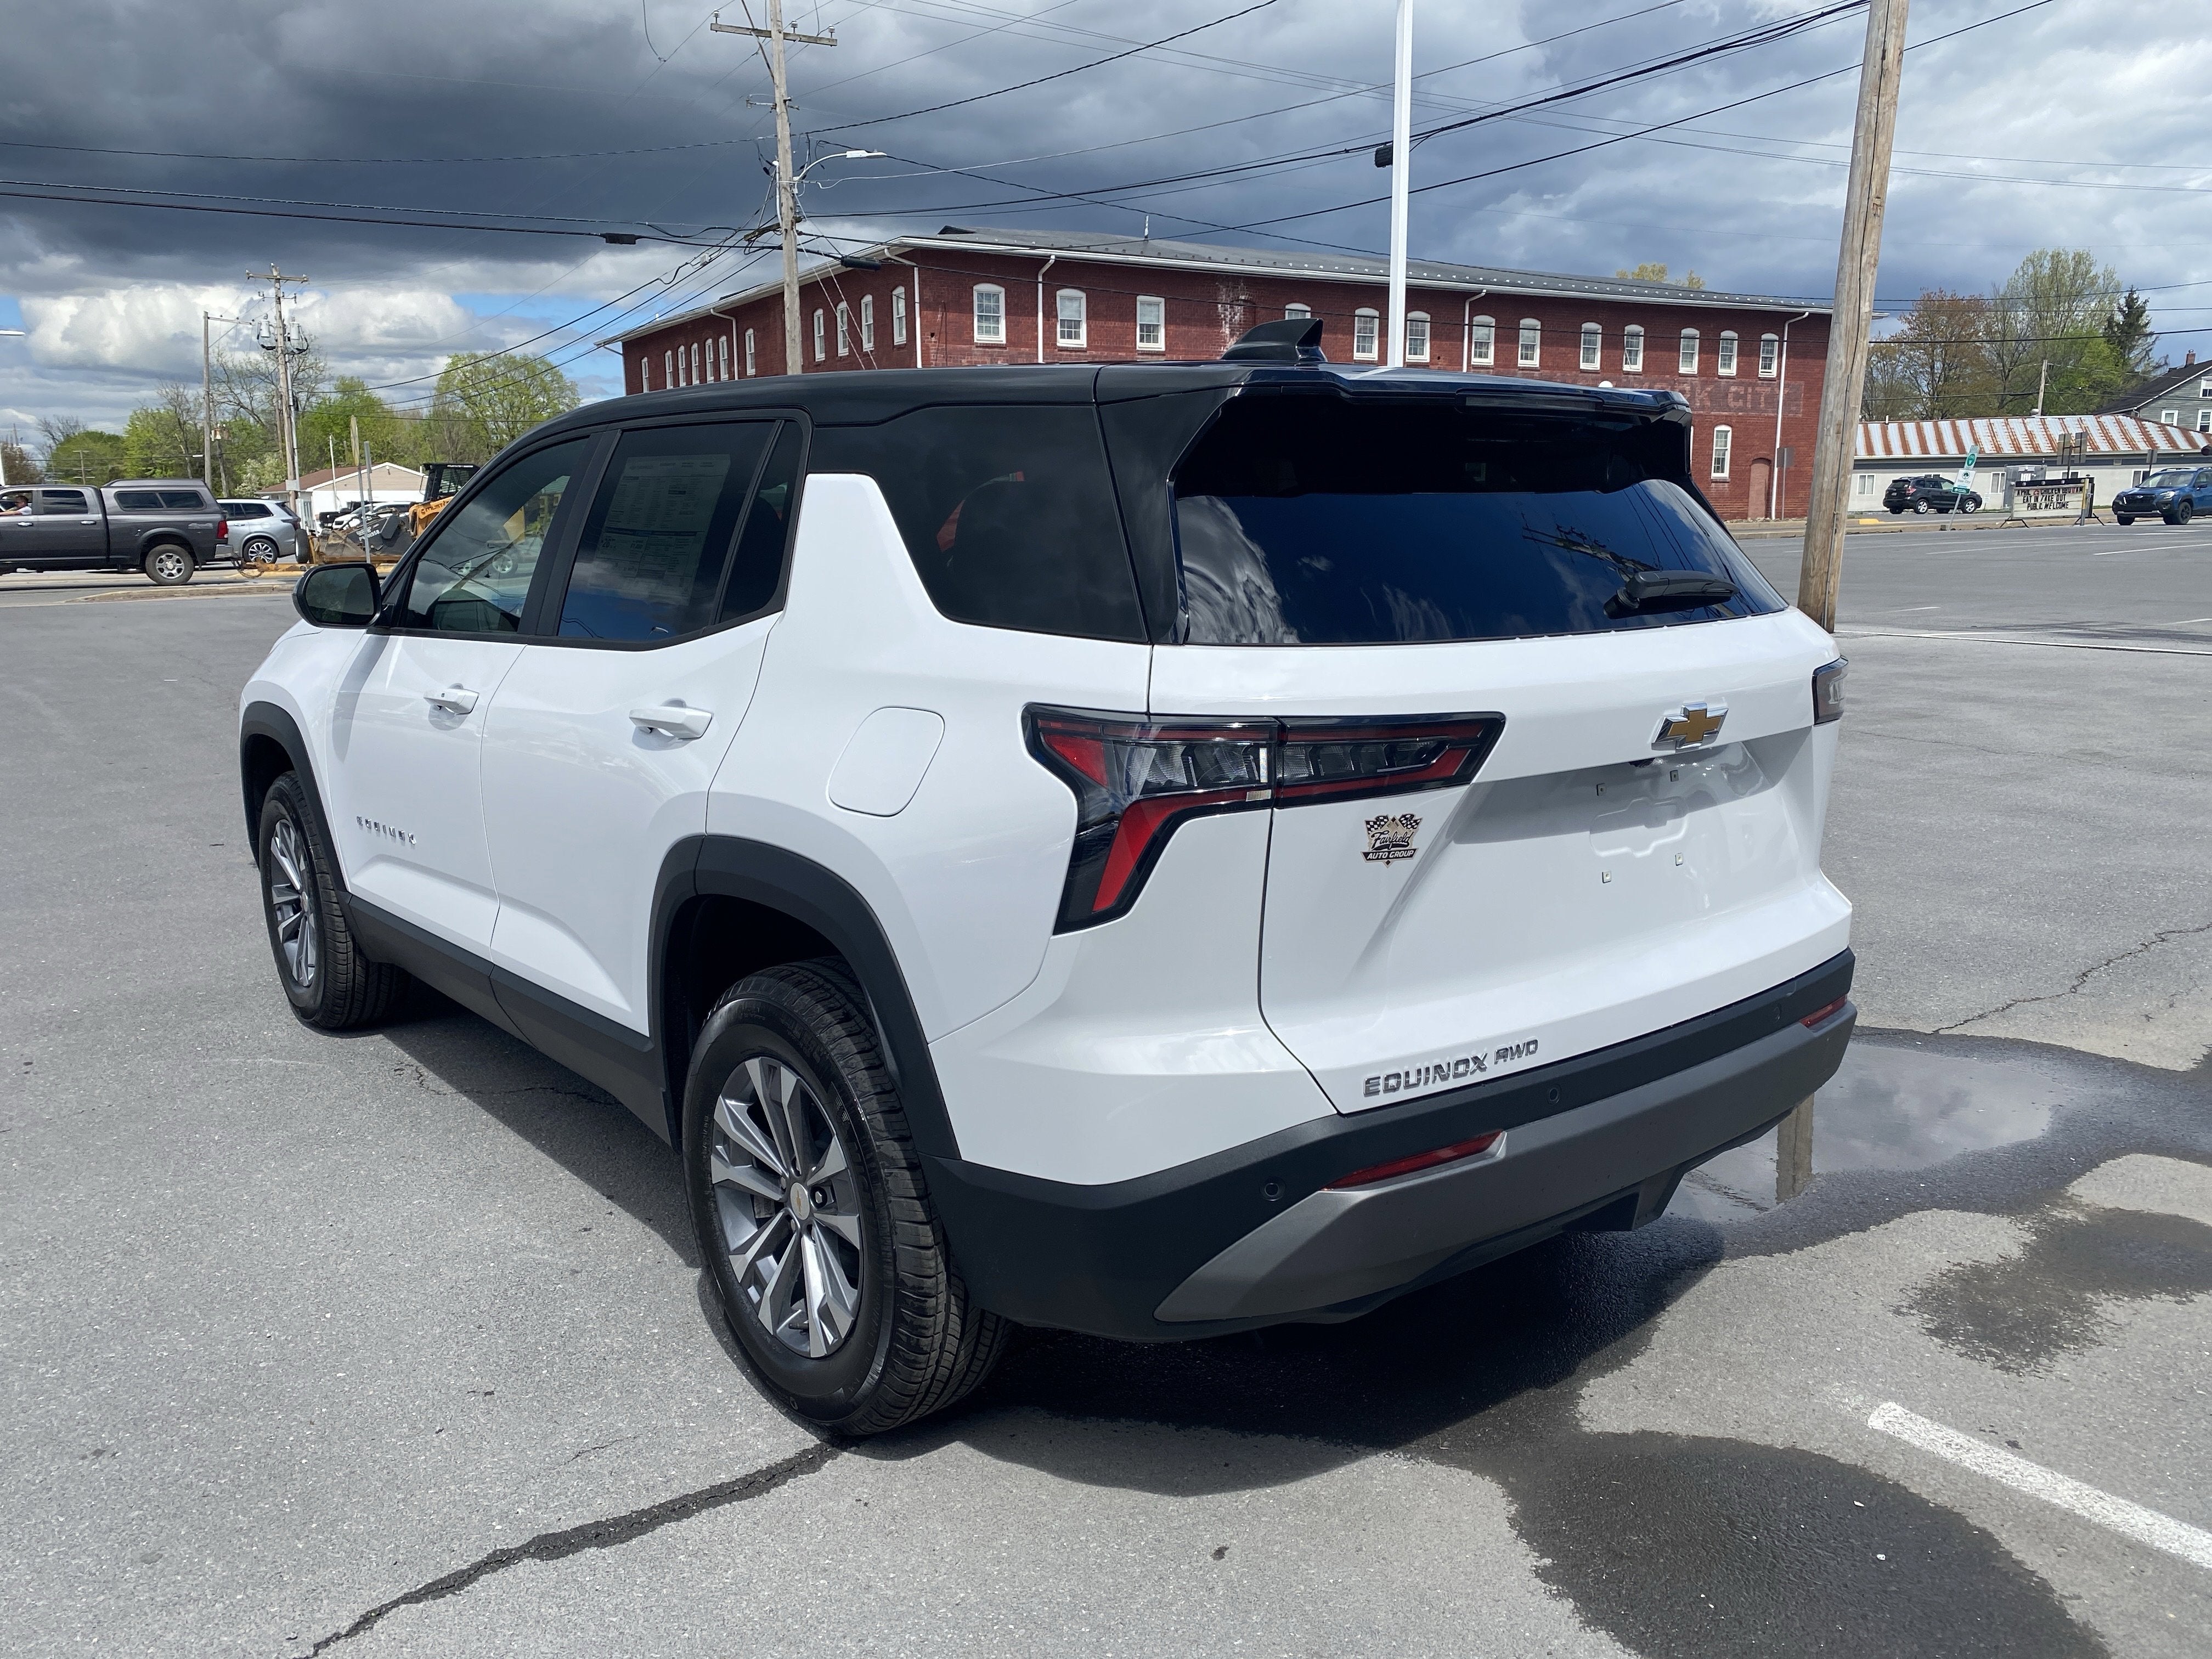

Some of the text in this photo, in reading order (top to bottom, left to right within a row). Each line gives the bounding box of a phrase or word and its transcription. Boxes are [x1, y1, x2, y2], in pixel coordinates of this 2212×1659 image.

[2023, 495, 2032, 504] EAT
[2034, 494, 2039, 503] IN
[2027, 501, 2069, 511] PUBLIC WELCOME
[1371, 830, 1414, 850] Fairfield
[1389, 850, 1414, 858] GROUP
[1363, 1039, 1538, 1097] EQUINOX AWD
